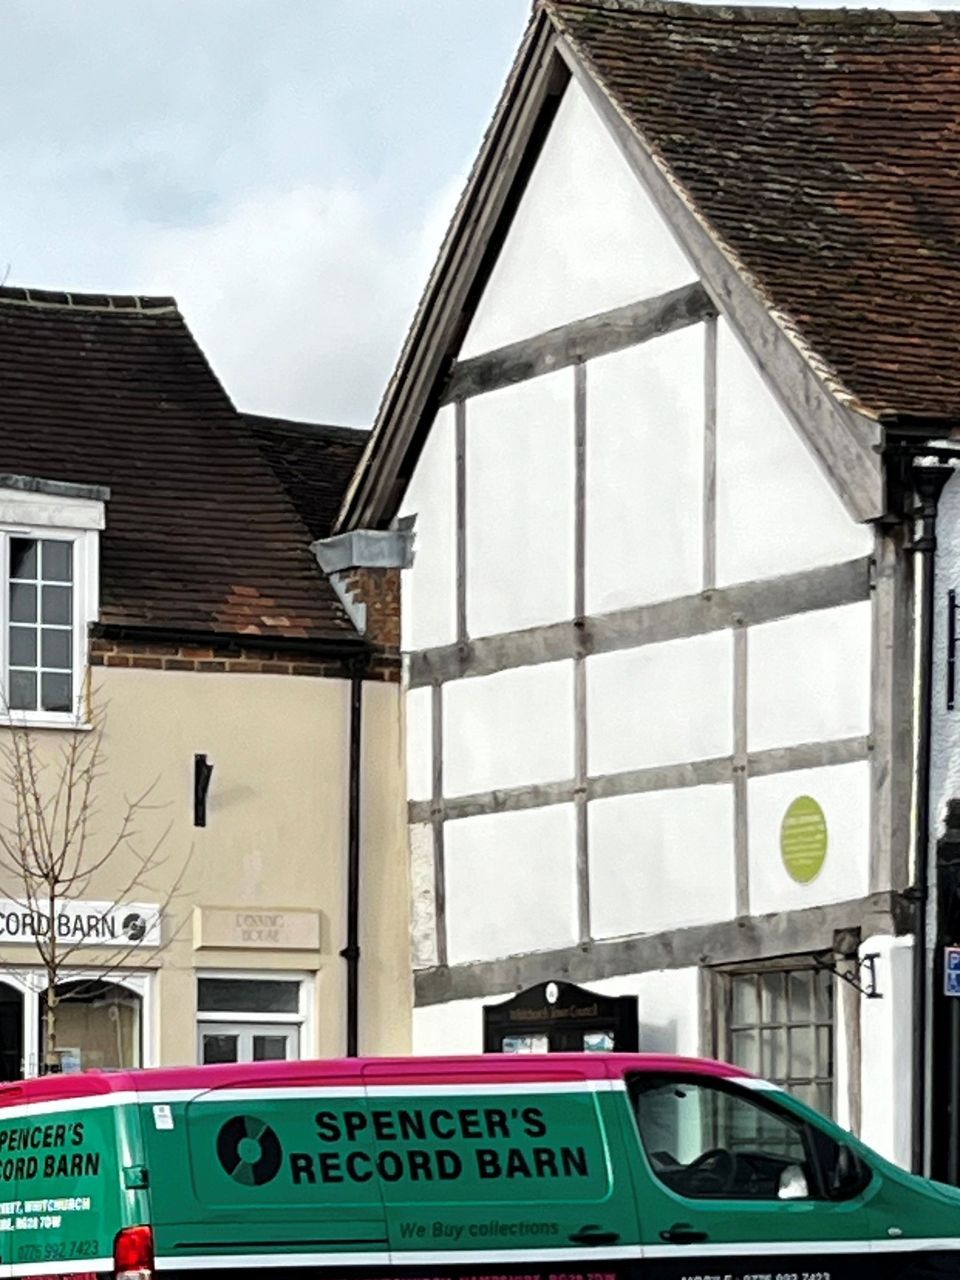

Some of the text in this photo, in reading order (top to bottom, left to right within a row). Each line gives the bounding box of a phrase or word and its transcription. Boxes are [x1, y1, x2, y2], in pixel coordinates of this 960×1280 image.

[57, 912, 116, 939] BARN
[315, 1107, 547, 1142] SPENCER'S
[43, 1152, 99, 1178] BARN
[289, 1146, 589, 1185] RECORD BARN
[400, 1220, 558, 1240] We Buy collections
